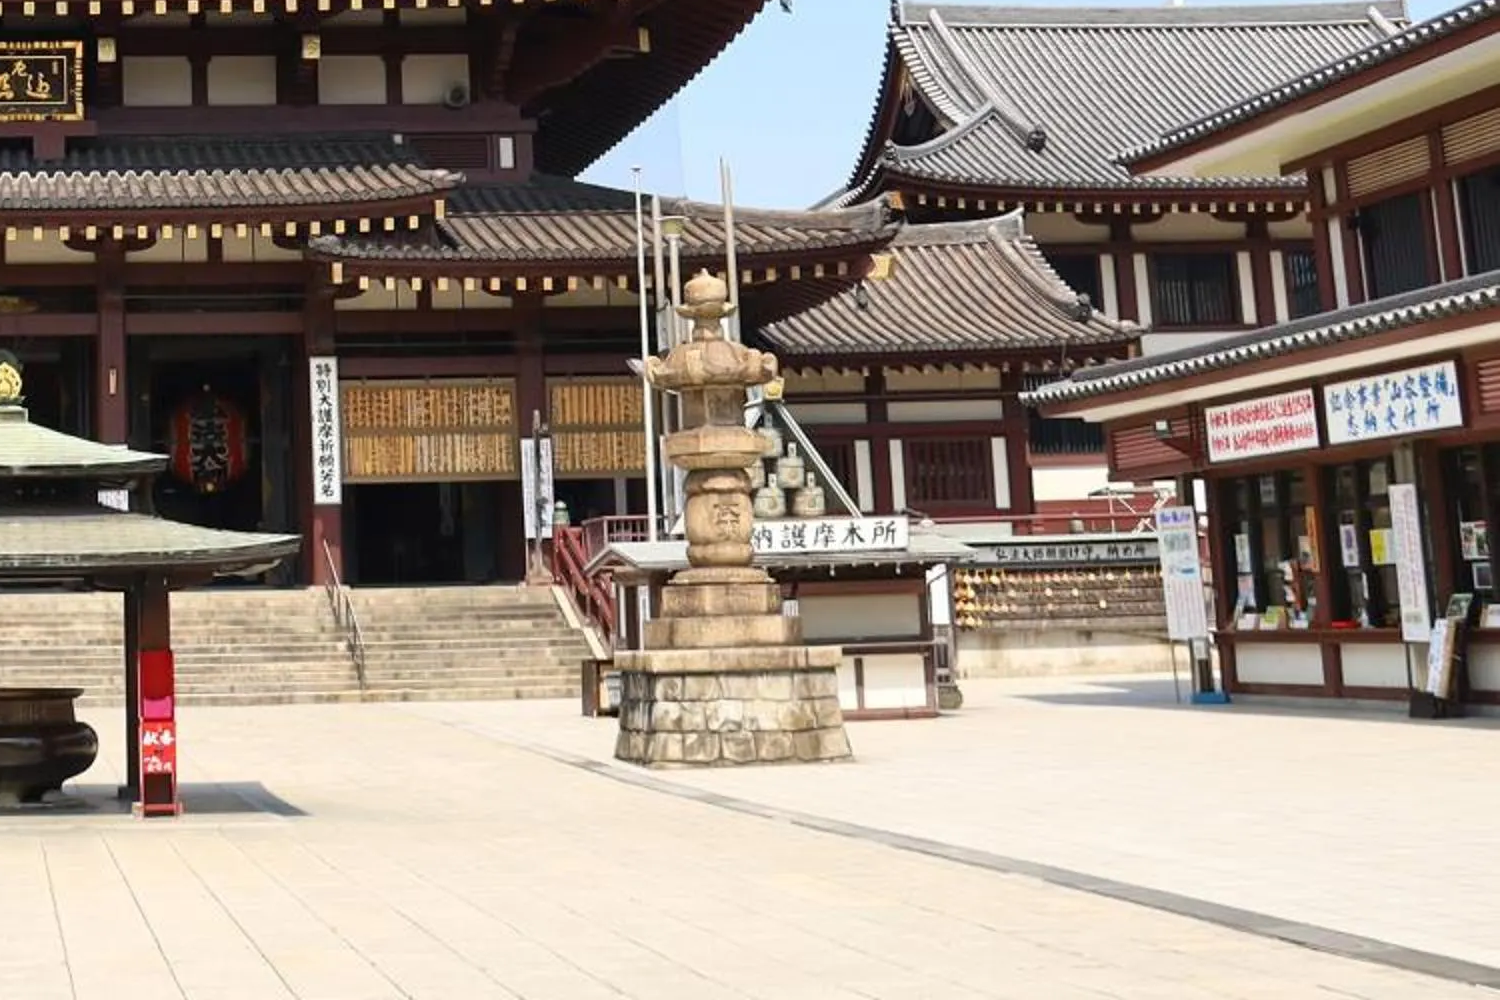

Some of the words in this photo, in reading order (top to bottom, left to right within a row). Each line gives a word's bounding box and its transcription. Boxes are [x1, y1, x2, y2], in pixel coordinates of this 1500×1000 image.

[315, 363, 334, 498] 特別大護摩祈願芳名
